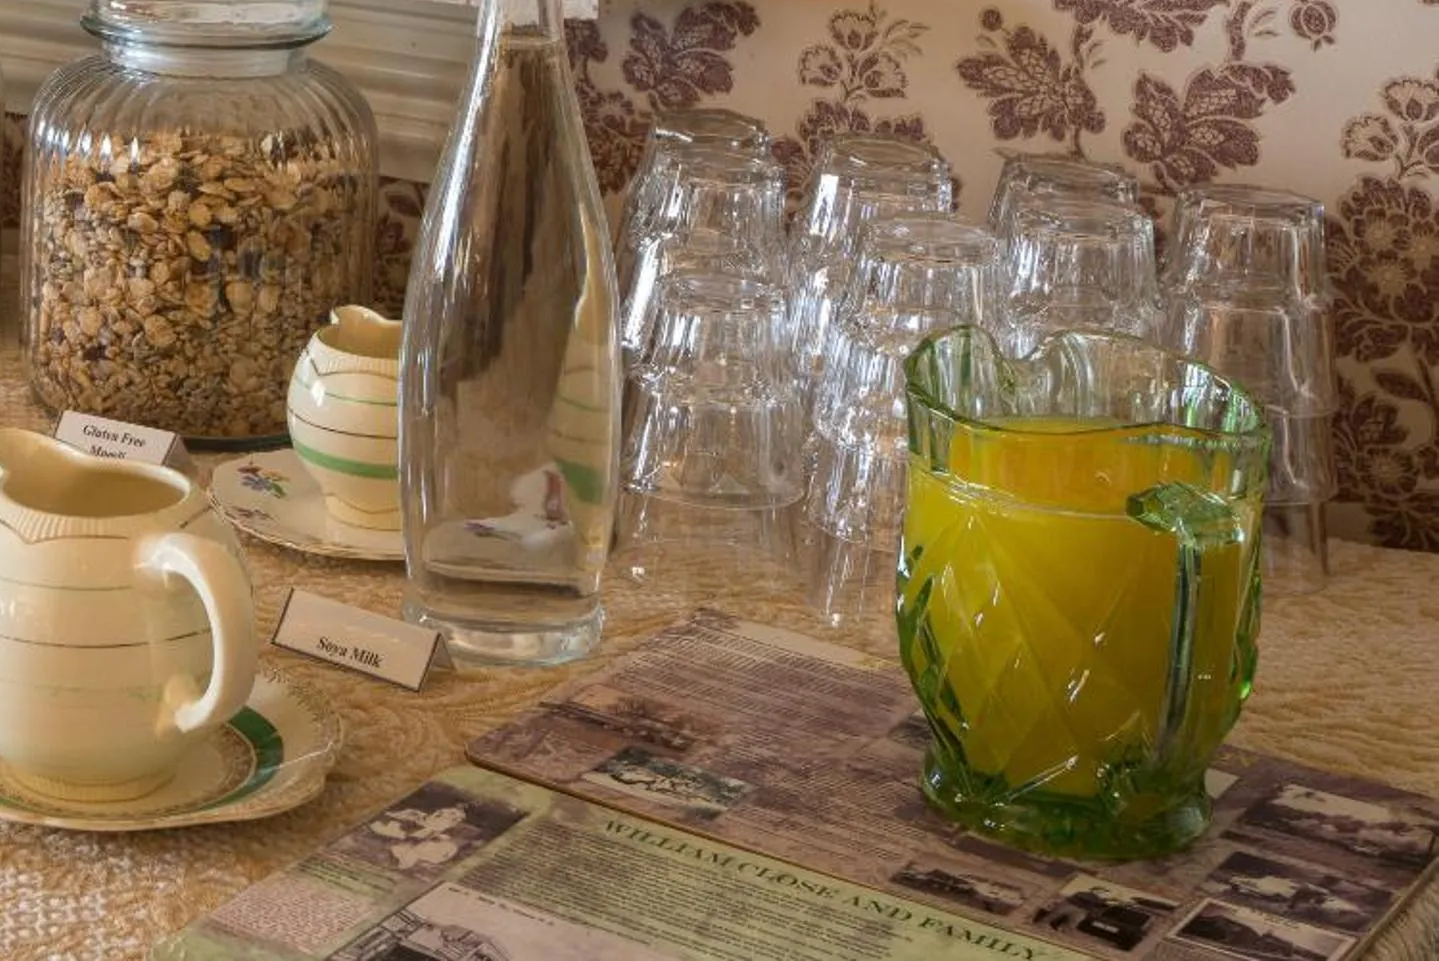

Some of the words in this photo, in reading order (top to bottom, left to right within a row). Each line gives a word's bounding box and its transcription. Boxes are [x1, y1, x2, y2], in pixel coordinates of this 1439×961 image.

[82, 424, 119, 442] Gluten
[121, 432, 146, 448] Free
[316, 635, 348, 657] Soya
[349, 646, 384, 668] Milk
[604, 819, 735, 869] WILLIAM
[737, 861, 840, 900] CLOSE
[840, 893, 914, 921] AND
[917, 915, 1050, 960] FAMILY
